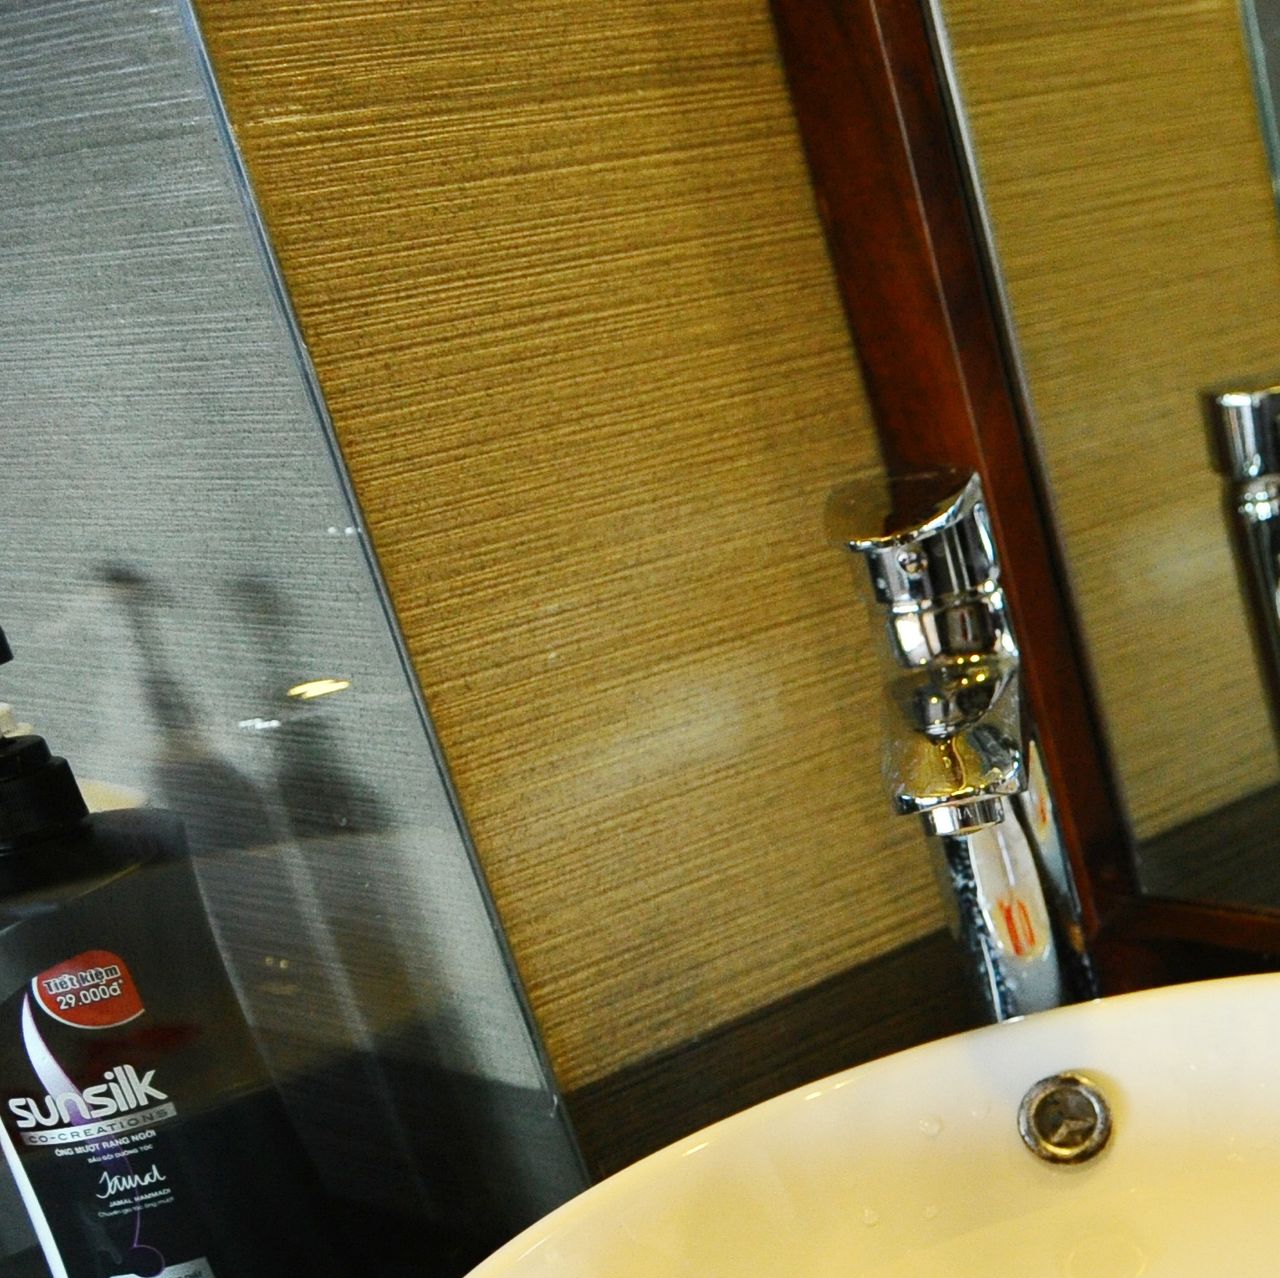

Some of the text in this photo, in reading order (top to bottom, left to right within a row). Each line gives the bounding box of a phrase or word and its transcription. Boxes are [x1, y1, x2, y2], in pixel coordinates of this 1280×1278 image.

[44, 965, 121, 995] Tiết kiệm
[8, 1064, 169, 1128] sunsilk
[28, 1108, 169, 1144] CO-CREATIONS
